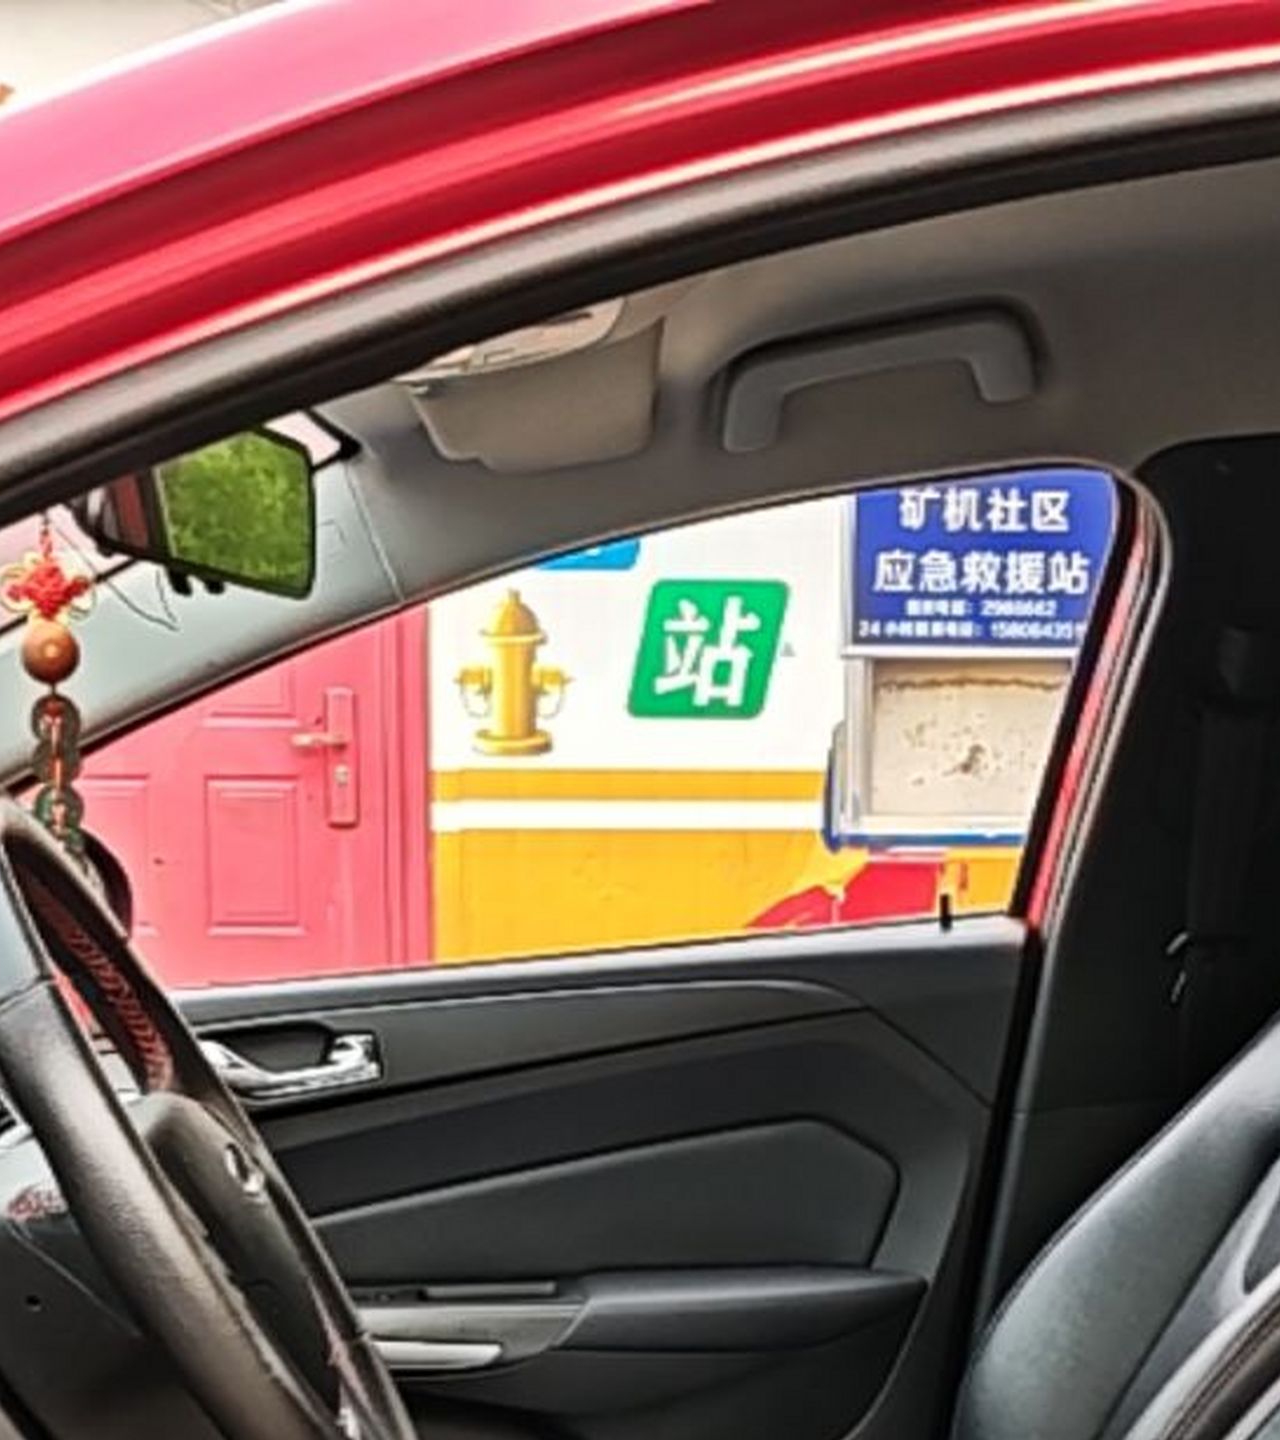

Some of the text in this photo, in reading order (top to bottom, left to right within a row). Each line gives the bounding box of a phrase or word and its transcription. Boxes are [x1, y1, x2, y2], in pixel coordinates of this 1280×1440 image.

[899, 487, 1071, 533] 矿机社区
[873, 550, 1091, 594] 应急救援站
[654, 596, 761, 707] 站
